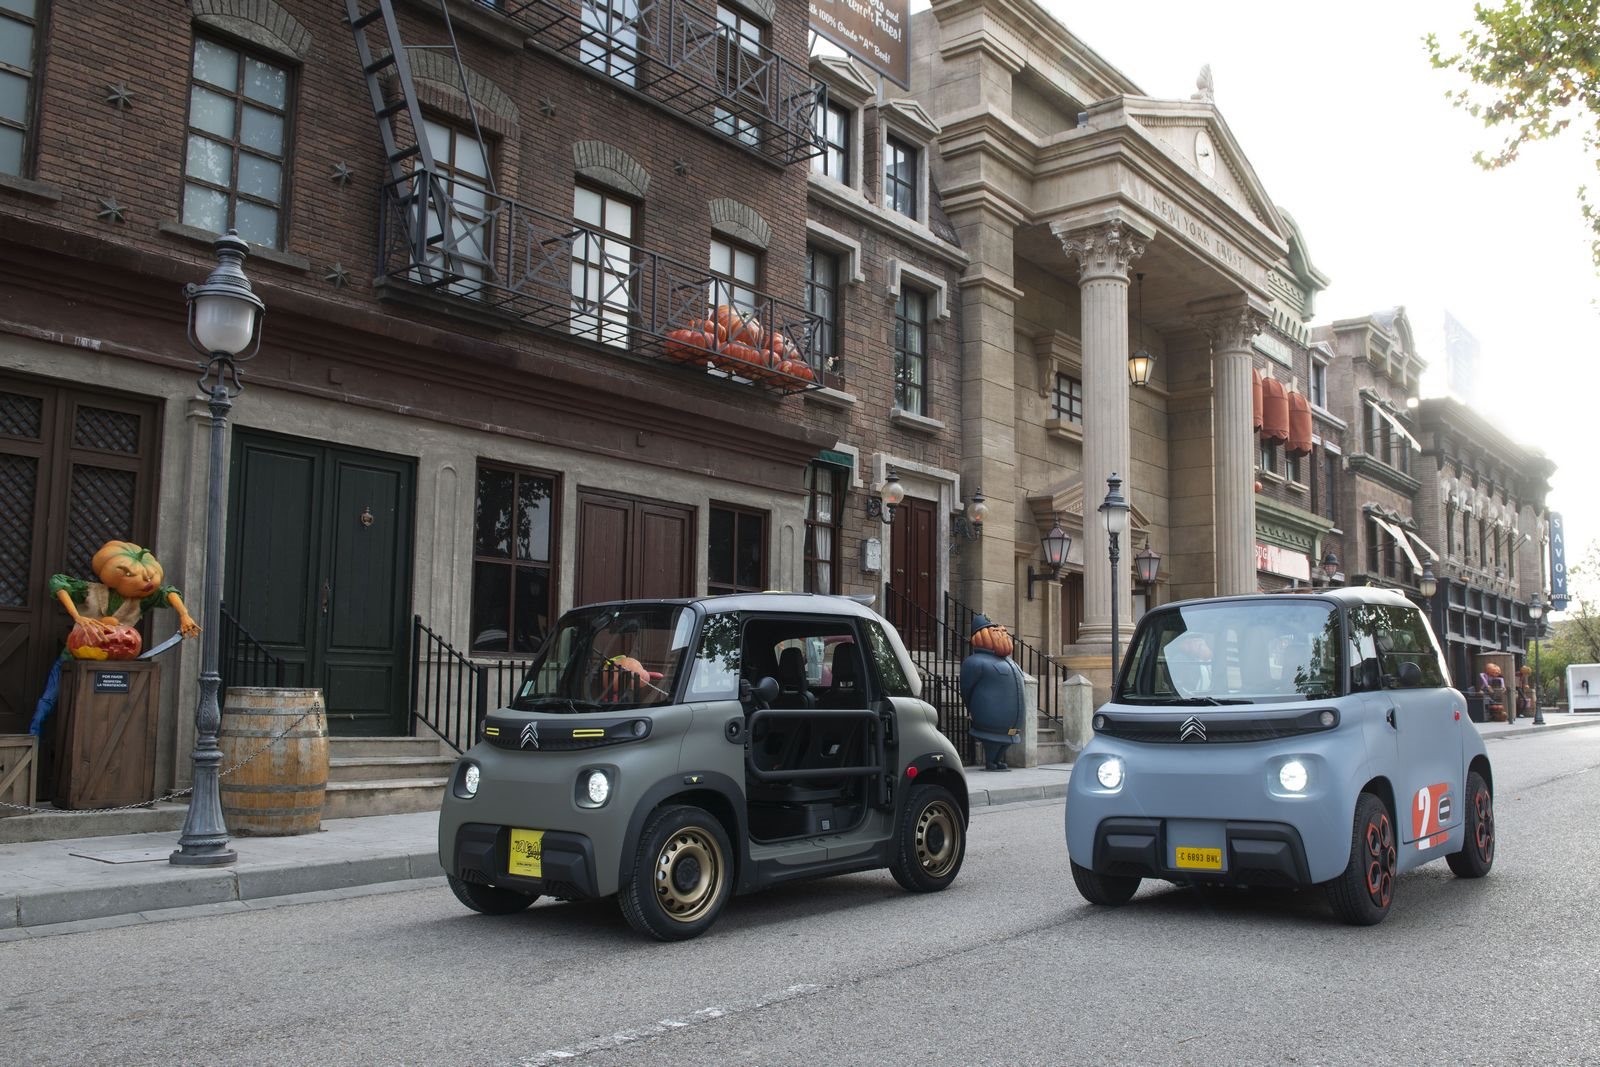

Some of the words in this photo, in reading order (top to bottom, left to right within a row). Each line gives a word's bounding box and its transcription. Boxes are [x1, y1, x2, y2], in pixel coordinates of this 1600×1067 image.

[819, 9, 837, 28] 100%
[837, 21, 858, 42] Grade
[875, 10, 902, 42] Fries!
[886, 9, 899, 24] and
[1152, 195, 1179, 229] NEW
[1183, 216, 1210, 247] YORK
[1214, 239, 1243, 269] TRUST
[1554, 518, 1564, 588] SAVOY
